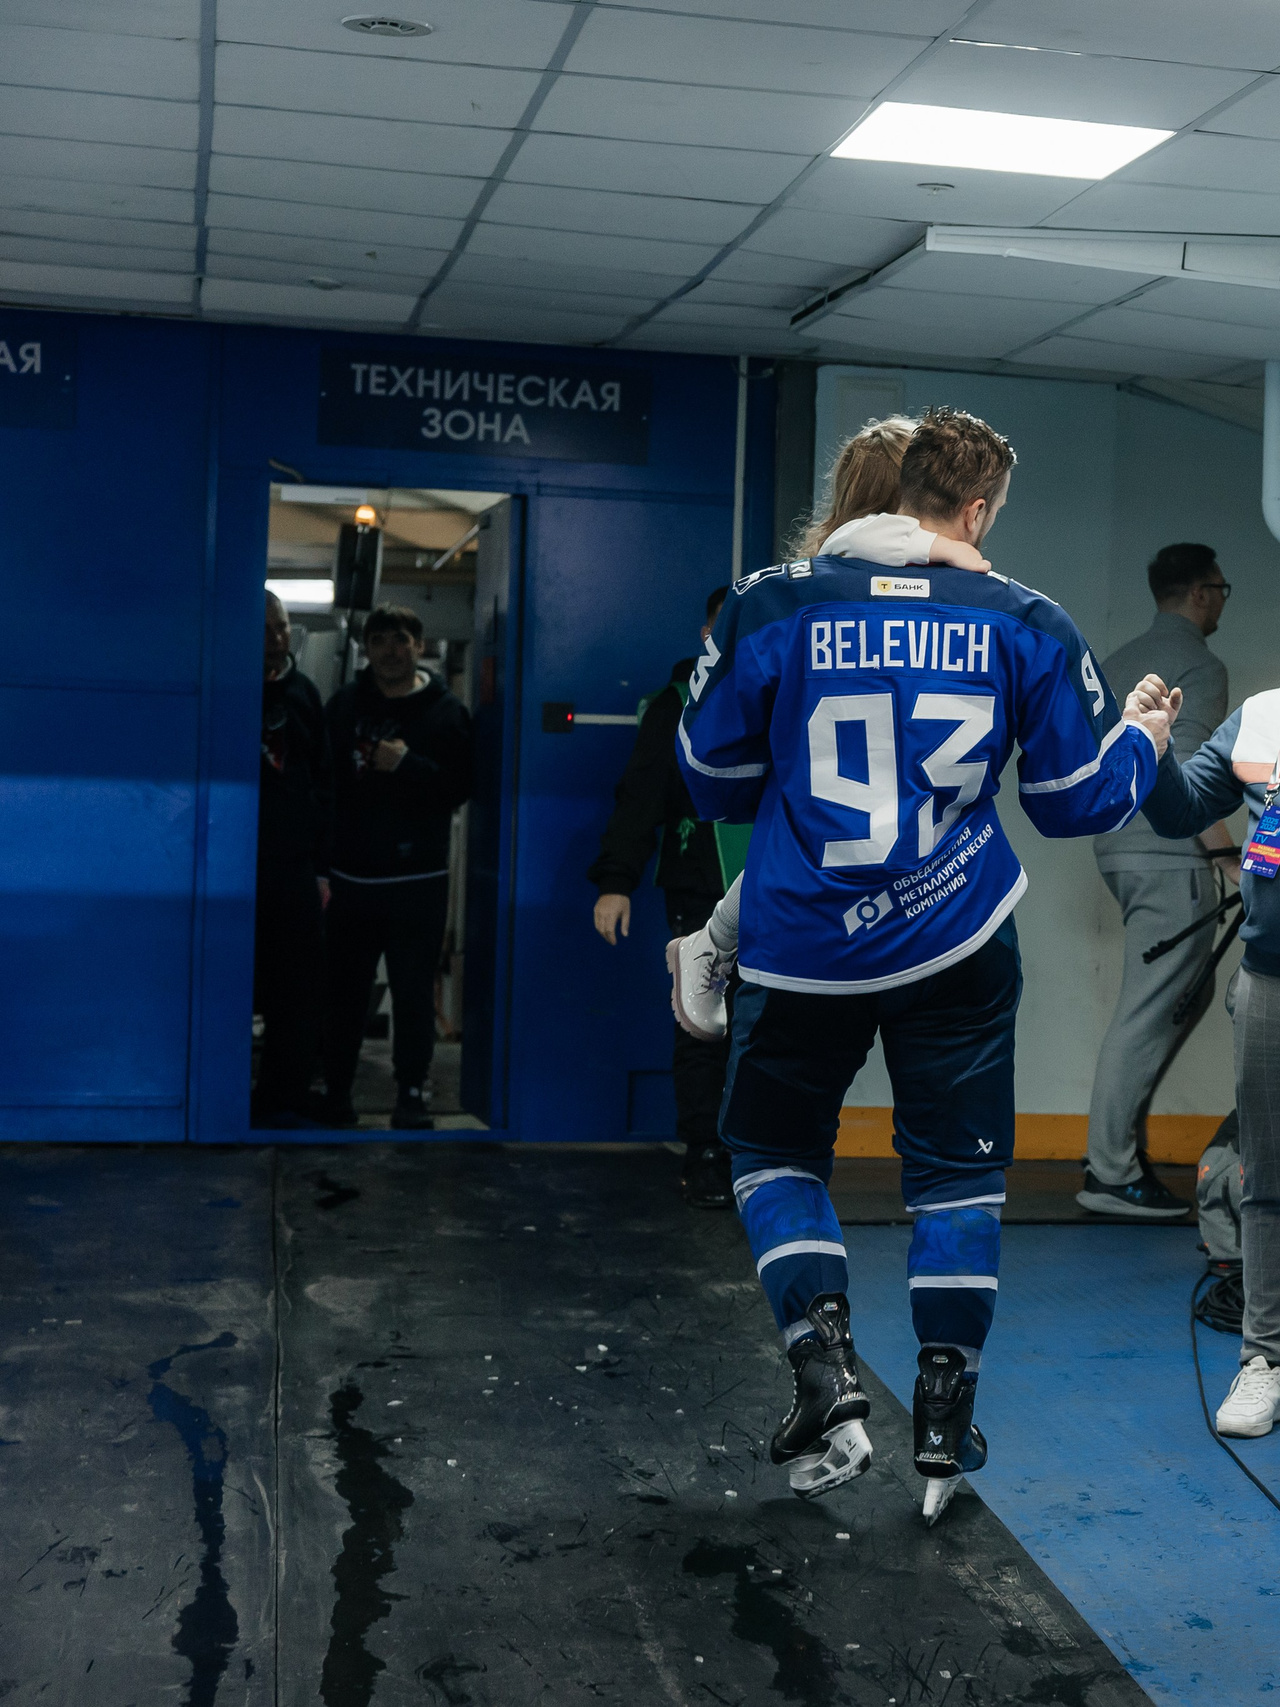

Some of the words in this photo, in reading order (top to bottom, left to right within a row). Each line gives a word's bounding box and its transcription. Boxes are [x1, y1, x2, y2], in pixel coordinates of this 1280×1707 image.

[350, 363, 621, 412] ТЕХНИЧЕСКАЯ
[421, 407, 531, 445] ЗОНА
[894, 583, 924, 591] БАНК
[810, 620, 991, 673] BELEVICH
[807, 693, 996, 868] 93
[1255, 834, 1268, 844] TV
[898, 823, 994, 906] МЕТАЛЛУРГИЧЕСКАЯ
[905, 872, 967, 919] КОМПАНИЯ
